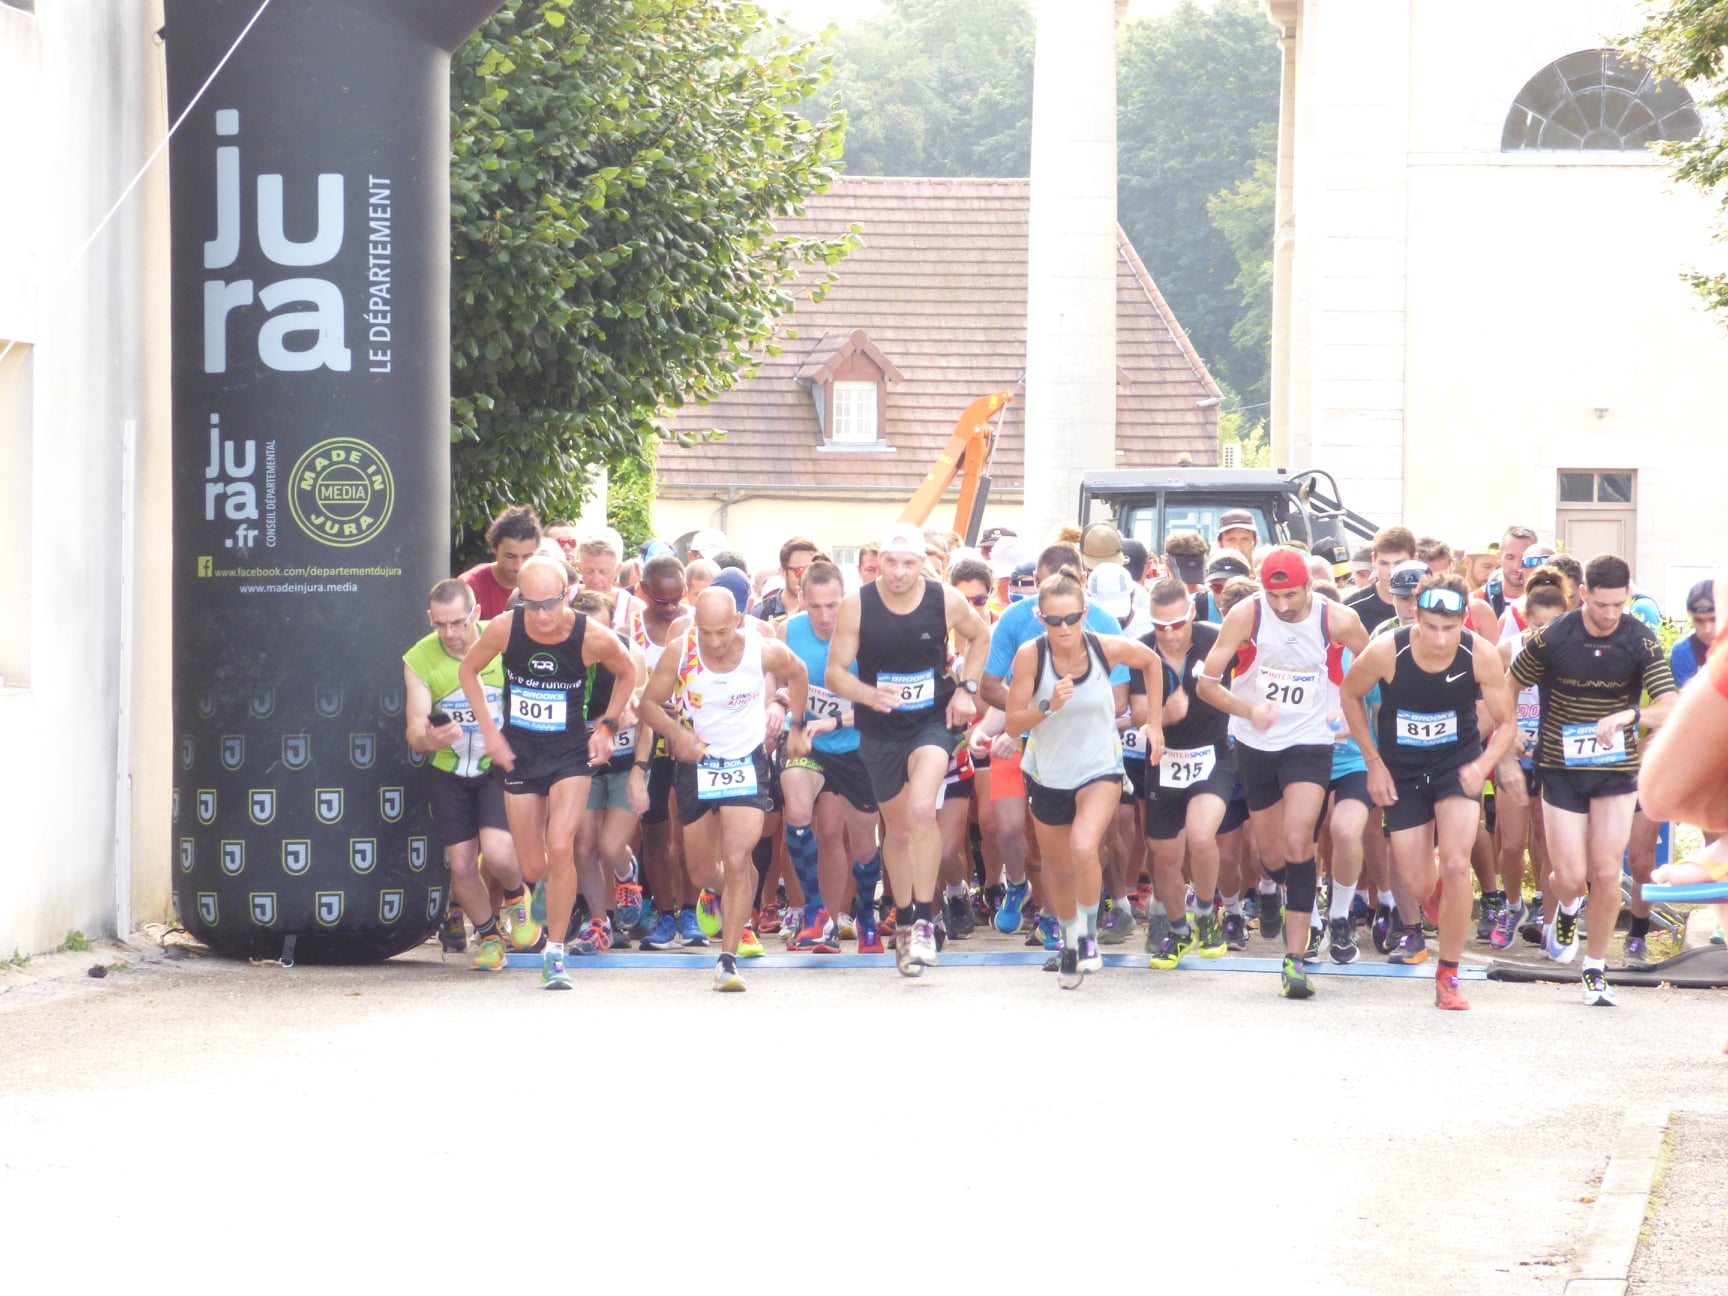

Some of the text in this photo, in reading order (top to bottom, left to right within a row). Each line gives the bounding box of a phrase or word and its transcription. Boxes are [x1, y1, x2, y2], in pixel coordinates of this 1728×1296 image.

[363, 174, 392, 373] LE DÉPARTEMENT
[300, 449, 385, 491] MADE IN
[264, 440, 276, 547] CONSEIL DÉPARTEMENTAL
[321, 485, 366, 499] MEDIA
[310, 513, 374, 536] JURA
[225, 523, 259, 548] .fr
[214, 565, 402, 579] www.facebook.com/departementdujura
[239, 582, 358, 594] www.madeinjura.media
[892, 671, 932, 683] BROOKS
[1268, 671, 1316, 683] INTERSPORT
[523, 690, 564, 700] BROOKS
[901, 684, 925, 701] 67
[1265, 682, 1304, 704] 210
[519, 700, 553, 719] 801
[809, 696, 840, 716] 172
[453, 711, 477, 723] 83
[1411, 711, 1455, 721] BROOKS
[1407, 722, 1446, 737] 812
[1167, 749, 1212, 759] INTERSPORT
[708, 769, 746, 787] 793
[1171, 761, 1204, 781] 215
